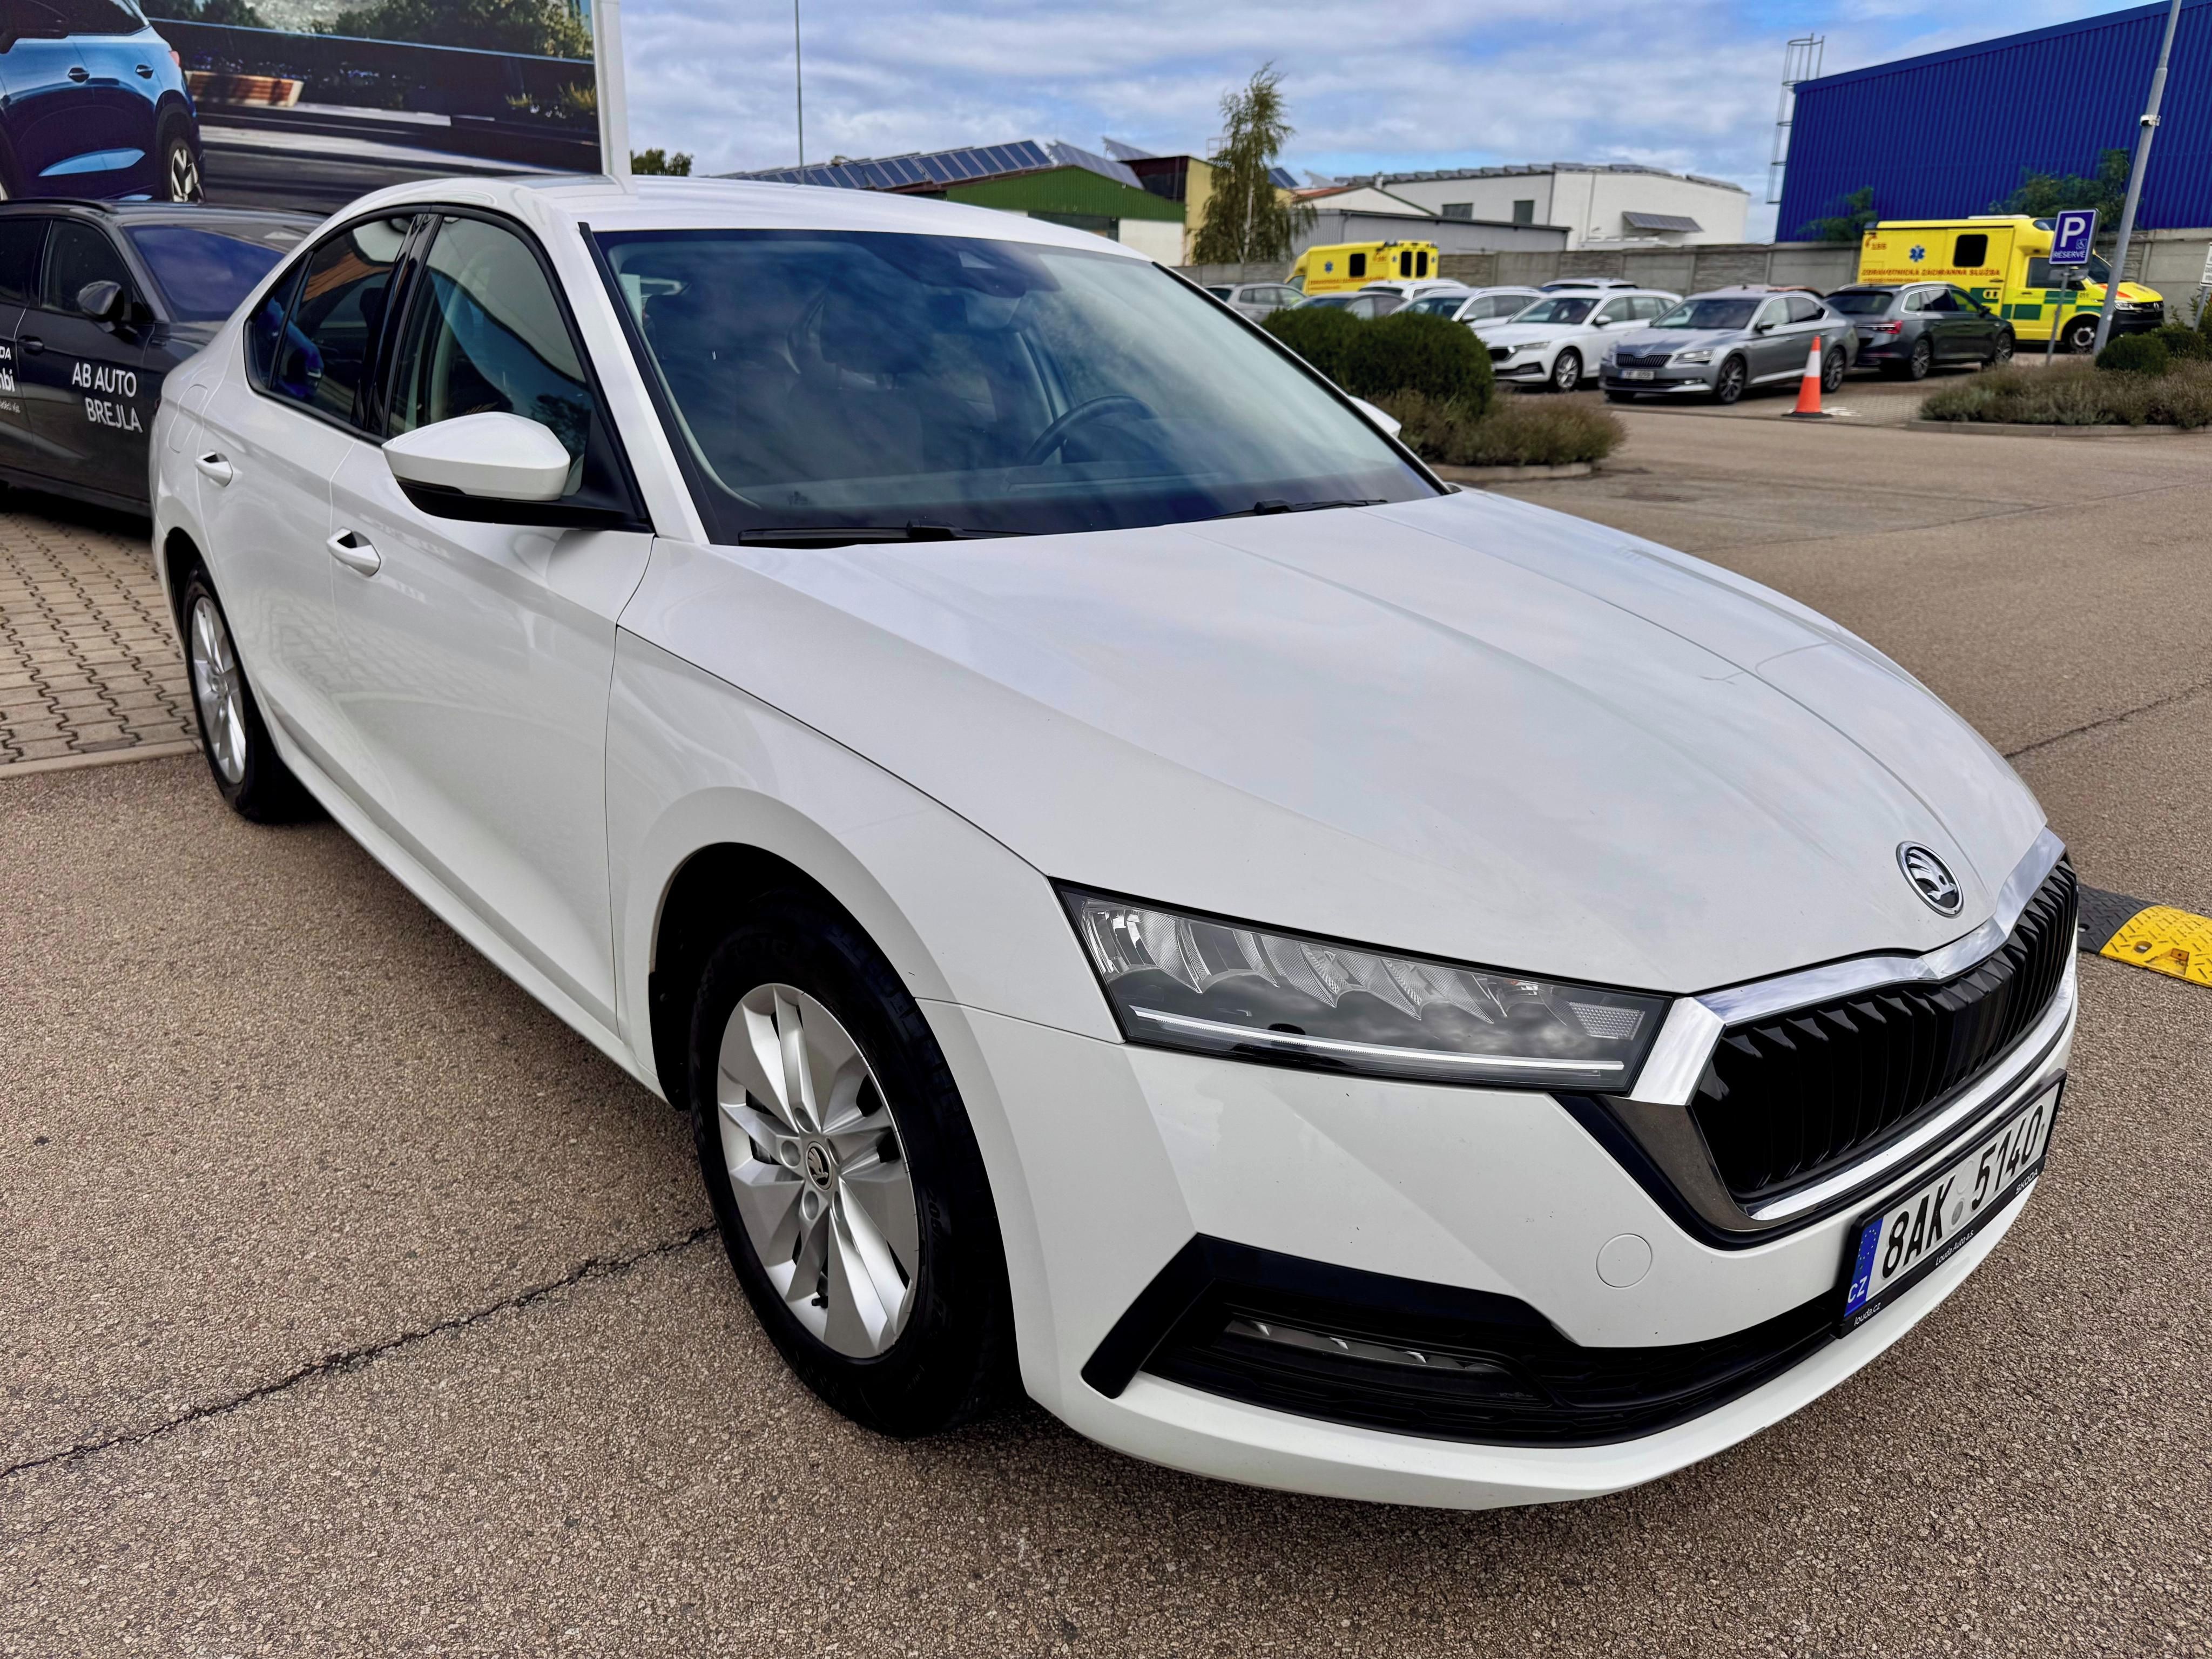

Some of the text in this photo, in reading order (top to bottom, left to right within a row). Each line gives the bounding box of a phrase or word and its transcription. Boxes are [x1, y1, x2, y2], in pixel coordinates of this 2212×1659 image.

[2060, 217, 2086, 247] P
[72, 361, 137, 397] AB AUTO
[85, 396, 143, 433] BREJLA
[1881, 1104, 2044, 1279] 8AK 5140
[1935, 1247, 1952, 1266] Louda
[1952, 1237, 1966, 1252] Auto
[1847, 1275, 1867, 1303] CZ
[1854, 1302, 1881, 1326] louda.cz
